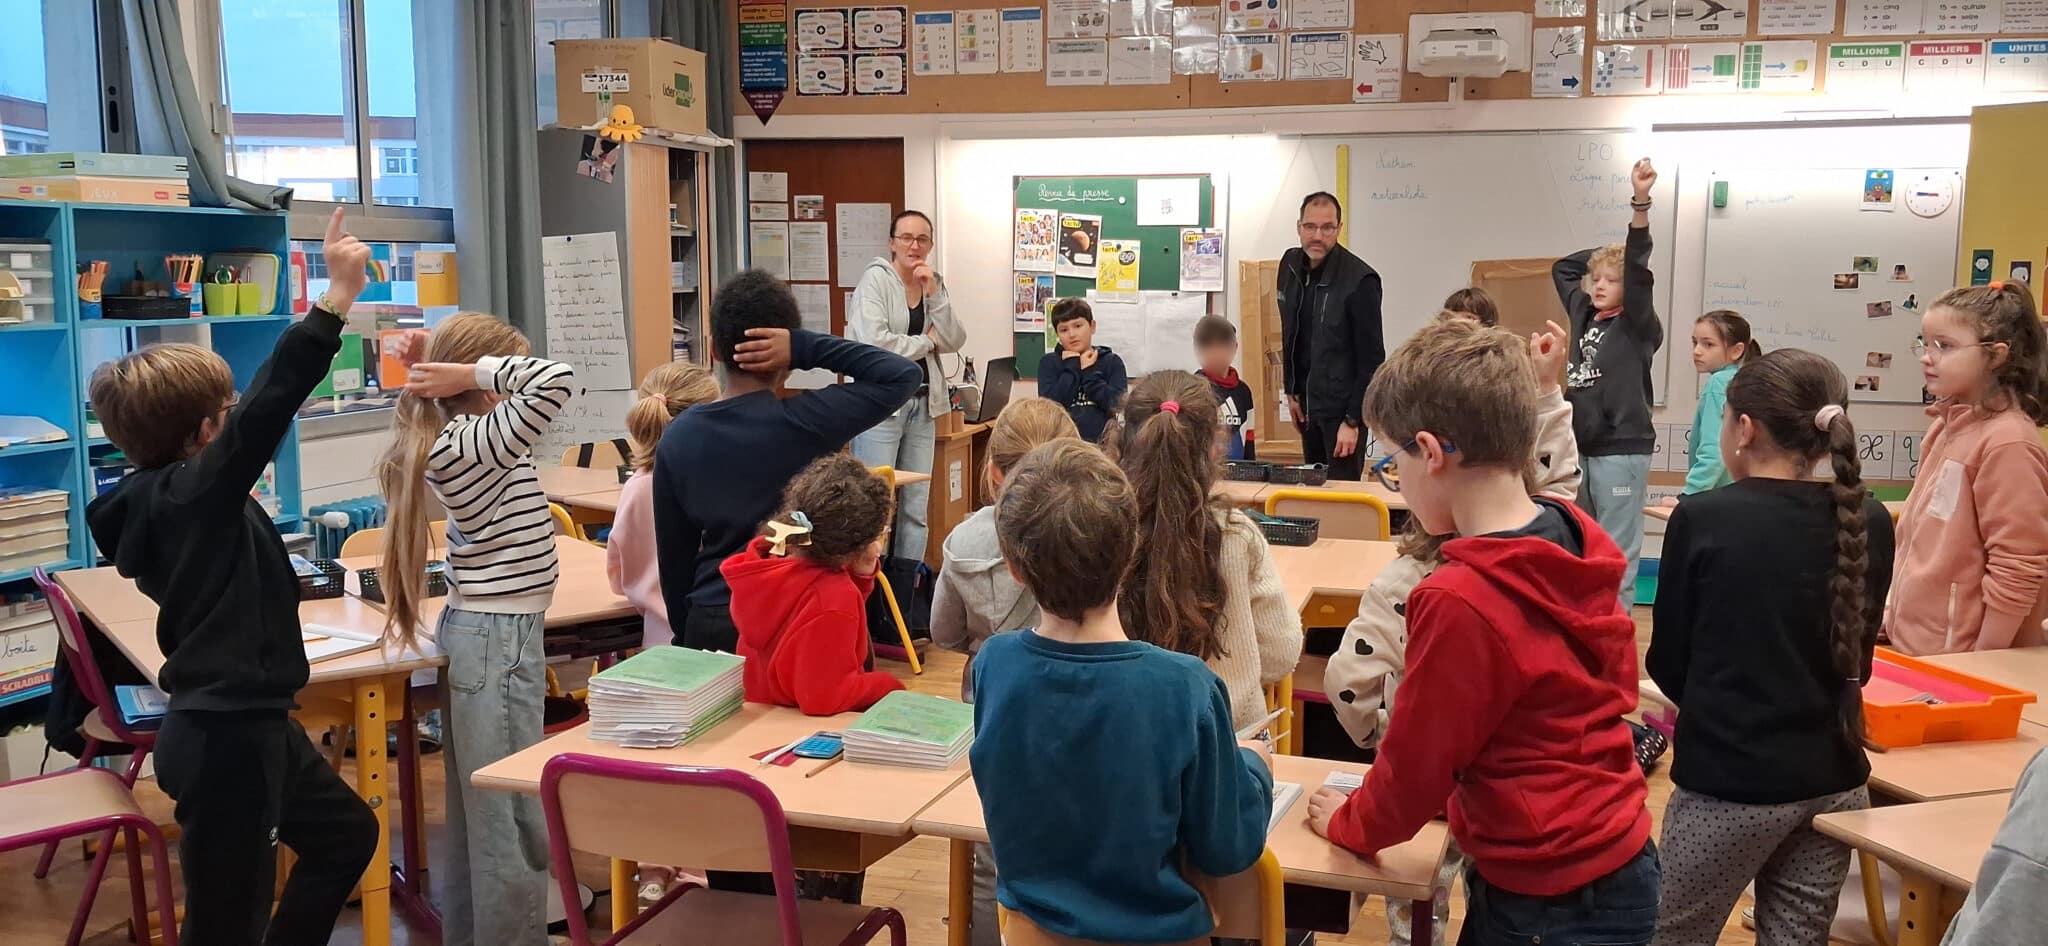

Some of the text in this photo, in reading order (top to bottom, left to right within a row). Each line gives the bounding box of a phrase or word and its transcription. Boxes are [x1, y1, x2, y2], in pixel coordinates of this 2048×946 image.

[1842, 47, 1890, 56] MILLIONS
[1922, 45, 1970, 54] MILLIERS
[1885, 59, 1892, 67] U
[599, 74, 627, 82] 37344
[1577, 142, 1613, 160] LPO
[1066, 185, 1076, 197] de
[1083, 190, 1110, 204] presse
[1, 672, 50, 693] SCRABBLE
